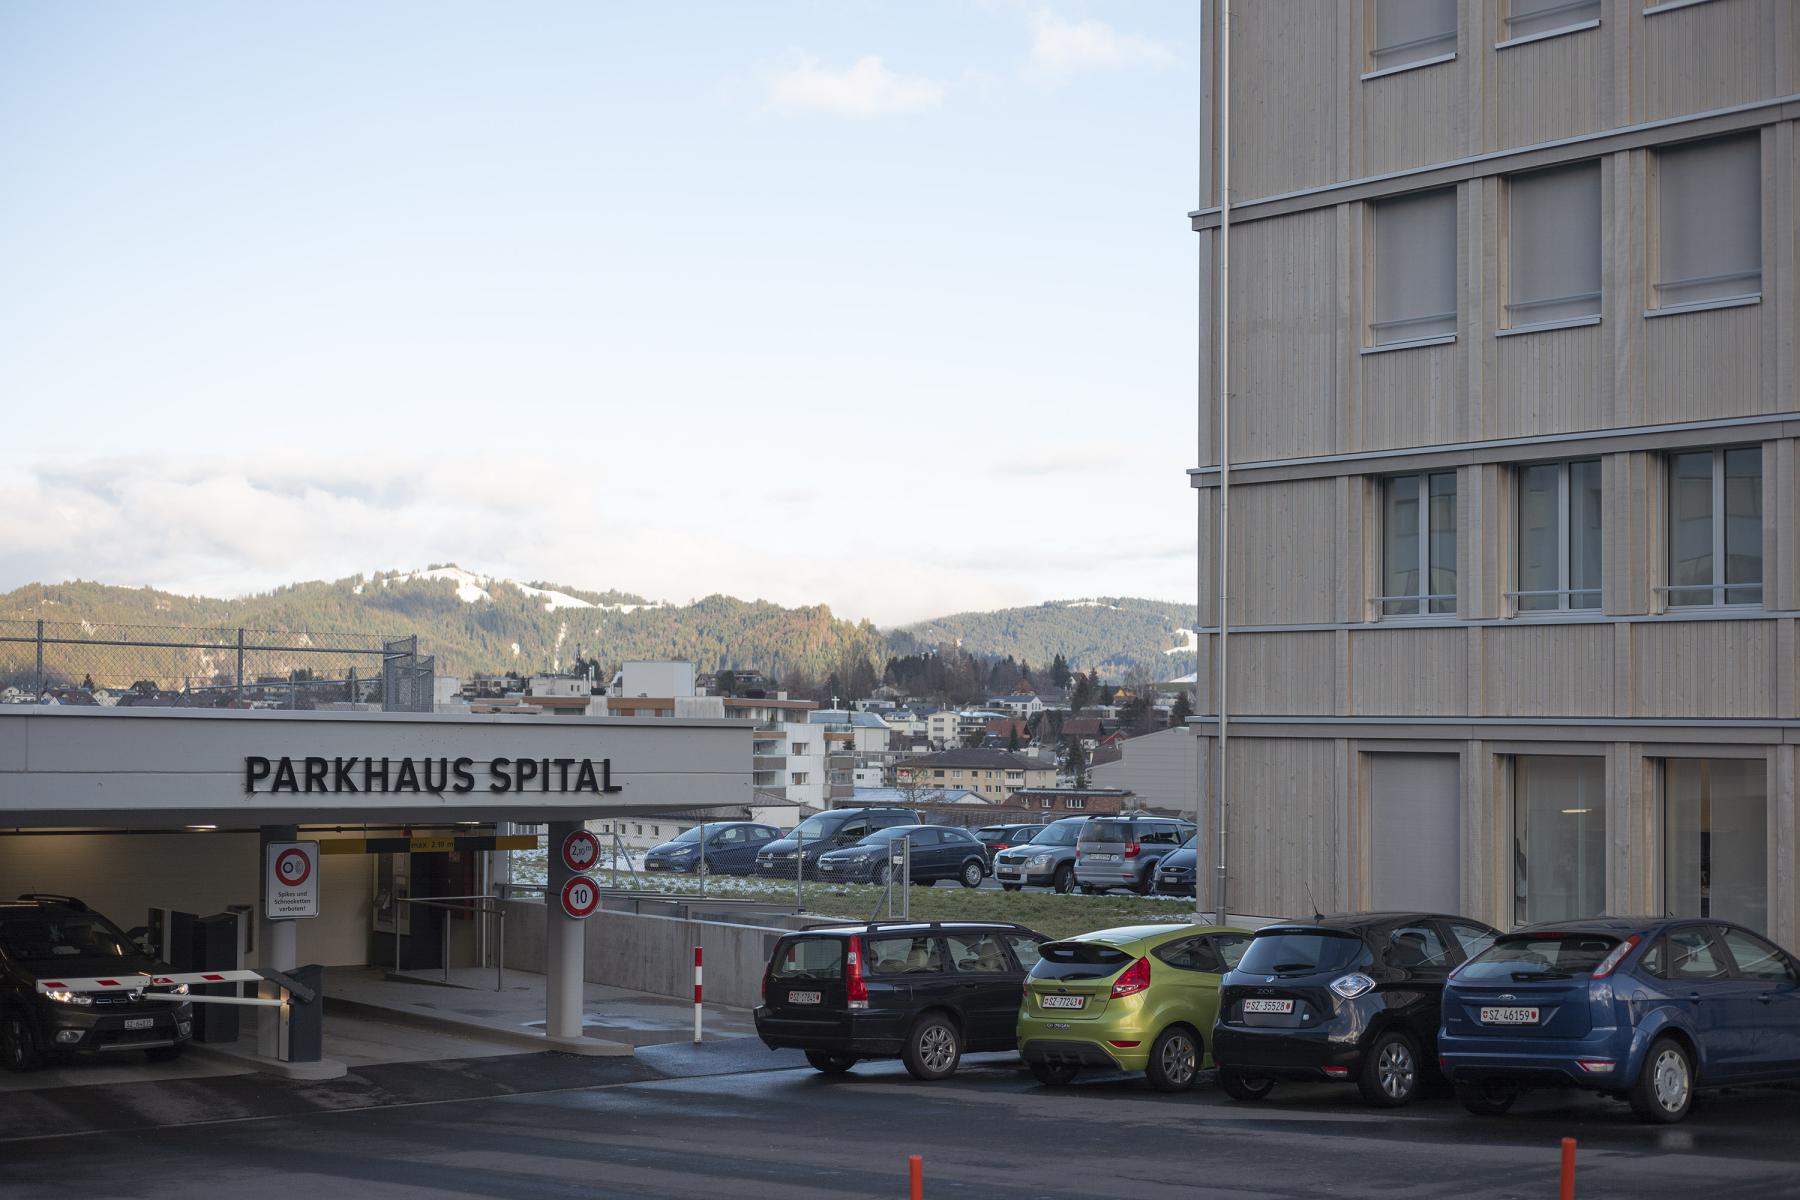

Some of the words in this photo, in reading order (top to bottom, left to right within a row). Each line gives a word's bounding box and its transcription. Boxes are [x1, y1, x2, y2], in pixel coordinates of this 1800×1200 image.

[246, 757, 474, 793] PARKHAUS
[490, 758, 622, 792] SPITAL
[574, 889, 588, 904] 10
